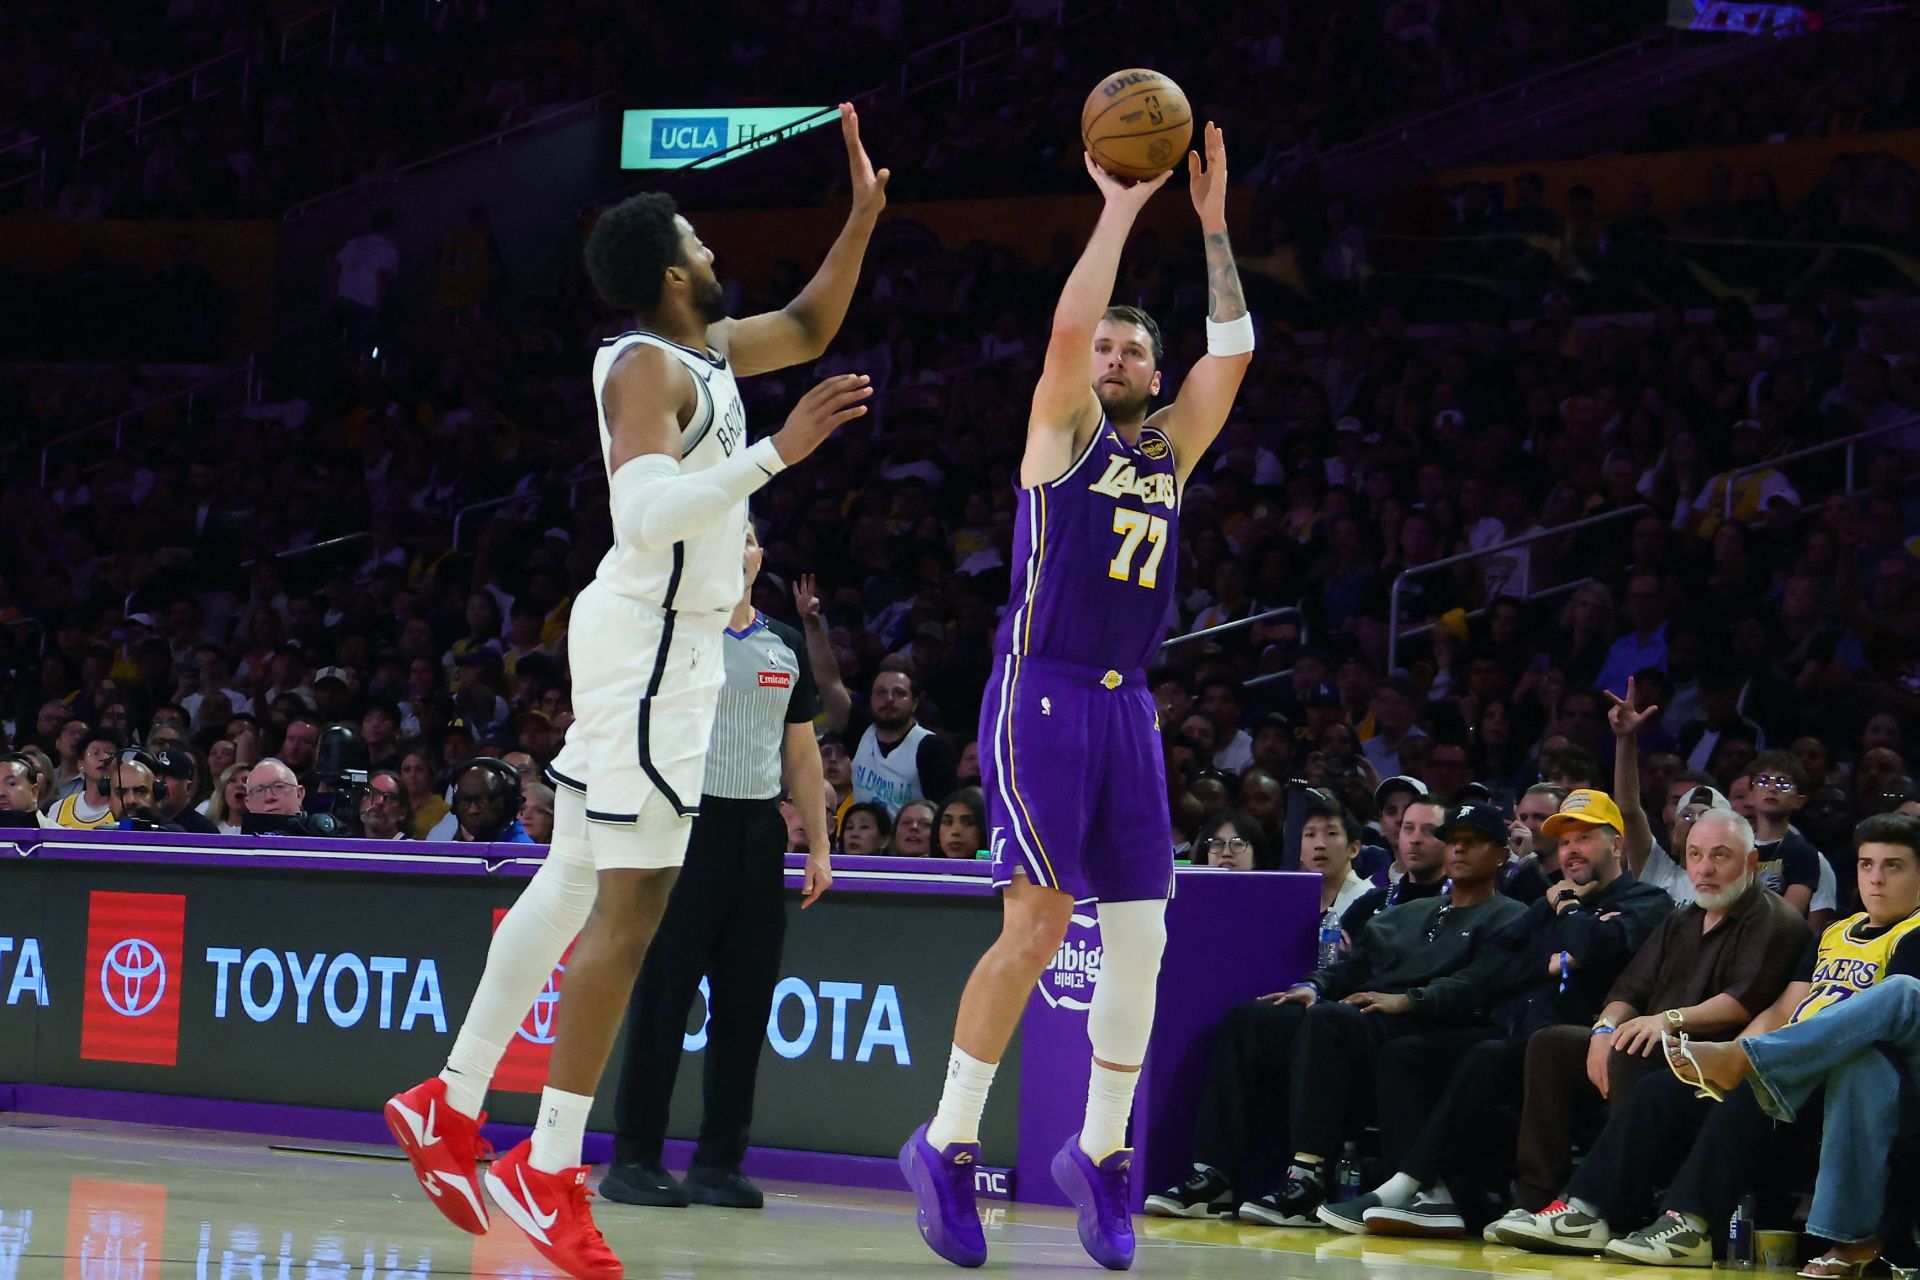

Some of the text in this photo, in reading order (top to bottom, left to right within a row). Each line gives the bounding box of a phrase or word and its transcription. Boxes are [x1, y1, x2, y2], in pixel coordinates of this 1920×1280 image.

[660, 127, 718, 149] UCLA
[1109, 507, 1168, 589] 77
[206, 947, 448, 1033] TOYOTA
[1046, 940, 1104, 982] ibig
[1054, 972, 1084, 988] 비비고
[683, 974, 911, 1066] OTA
